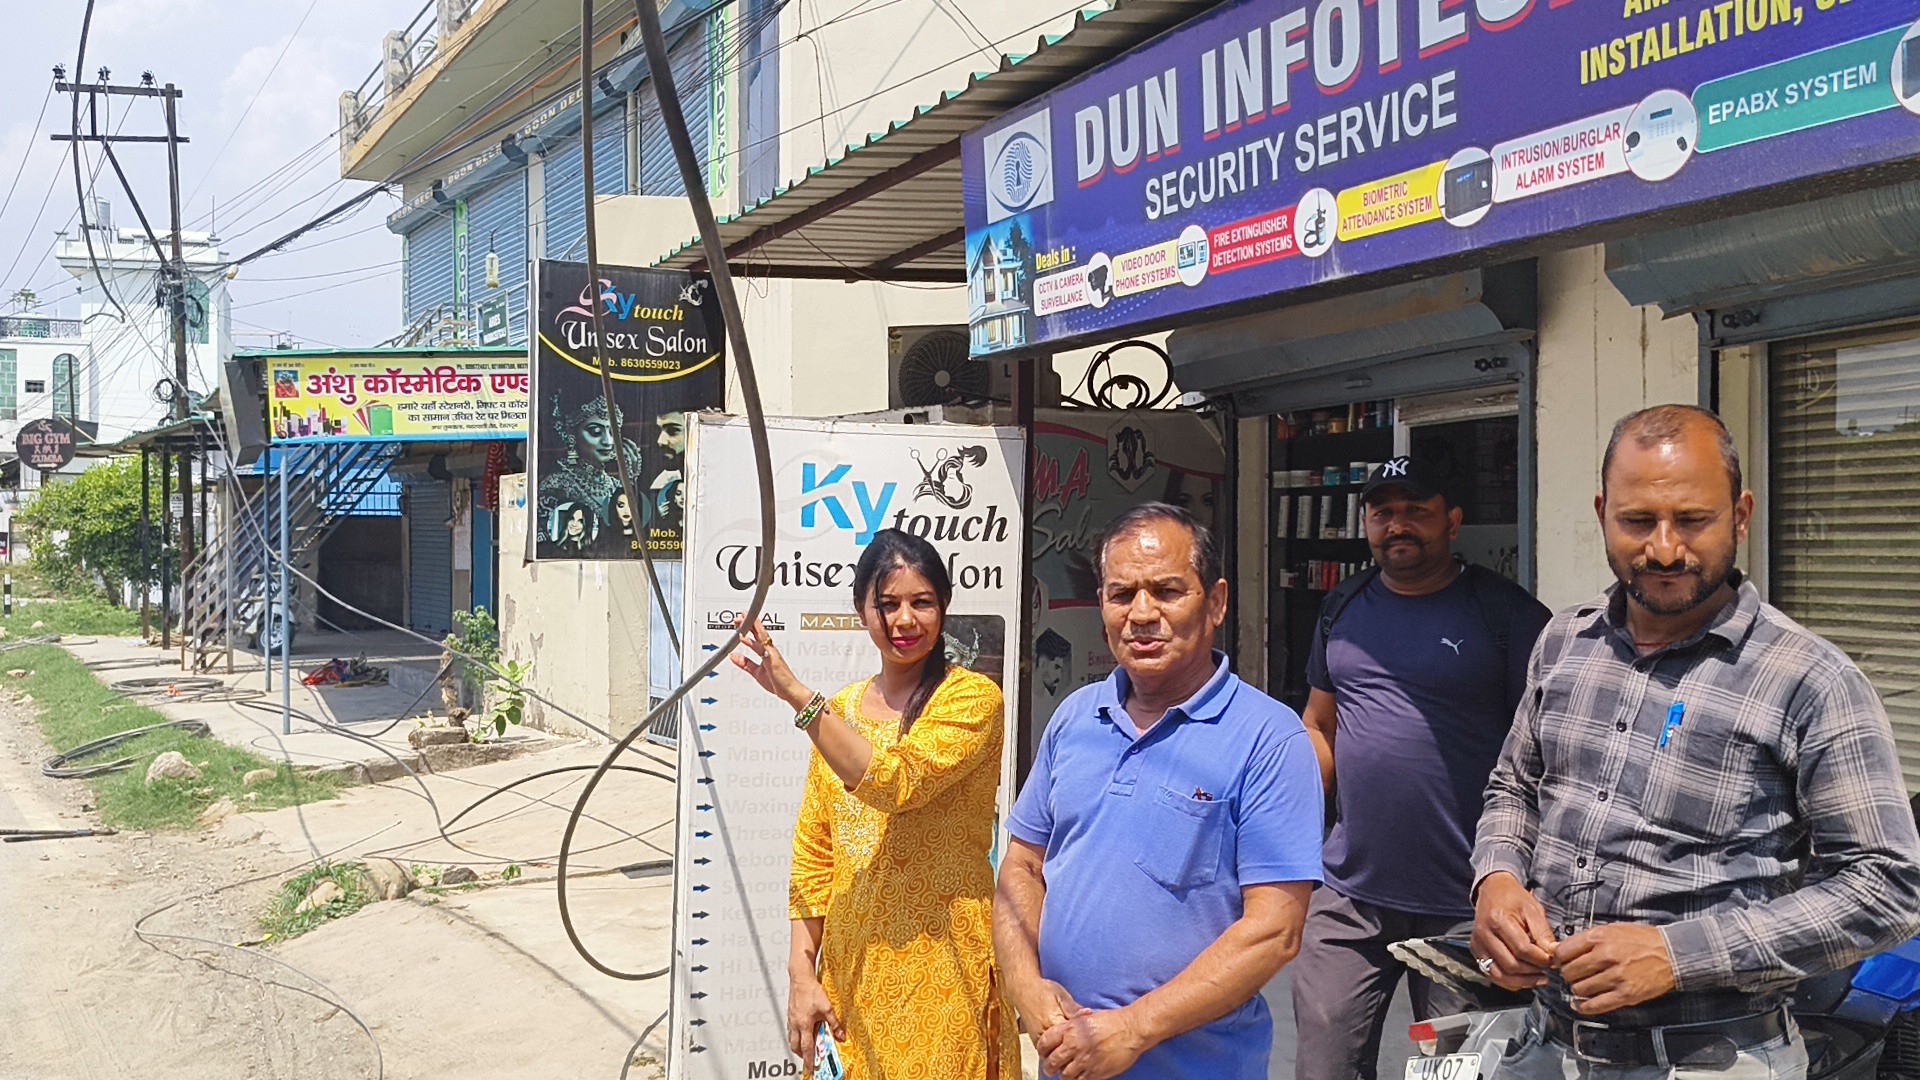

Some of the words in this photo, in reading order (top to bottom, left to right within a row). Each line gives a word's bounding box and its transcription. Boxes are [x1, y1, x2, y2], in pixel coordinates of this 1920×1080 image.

[1581, 0, 1803, 85] INSTALLATION,
[1708, 87, 1779, 125] EPABX
[1785, 61, 1878, 105] SYSTEM
[1075, 67, 1180, 187] DUN
[1145, 131, 1286, 220] SECURITY
[1294, 70, 1458, 172] SERVICE
[1501, 121, 1622, 171] INTRUSION/BURGLAR
[1515, 166, 1555, 191] ALARM
[1557, 152, 1605, 180] SYSTEM
[1363, 181, 1409, 207] BIOMETRIC
[1342, 205, 1396, 233] ATTENDANCE
[1397, 195, 1433, 219] SYSTEM
[1213, 230, 1230, 247] FIRE
[1231, 215, 1288, 243] EXTINGUISHER
[1035, 247, 1060, 271] Deals
[1060, 245, 1071, 263] in
[1121, 255, 1143, 273] VIDEO
[1144, 250, 1166, 266] DOOR
[1212, 245, 1254, 268] DETECTION
[1254, 234, 1293, 257] SYSTEMS
[1038, 282, 1053, 295] CCTV
[1060, 273, 1085, 289] CAMERA
[1115, 274, 1140, 292] PHONE
[1141, 265, 1176, 285] SYSTEMS
[634, 304, 684, 321] touch
[1040, 290, 1083, 311] SURVEILLANCE
[561, 320, 640, 350] Unsex
[645, 325, 707, 357] Salon
[620, 358, 681, 370] 8630559023
[306, 366, 357, 405] अंशु
[362, 365, 483, 395] कॉस्मेटिक
[21, 433, 43, 445] BIG
[44, 432, 71, 445] GYM
[650, 528, 680, 538] Mob.
[893, 505, 1009, 543] touch
[748, 1059, 802, 1080] Mob.
